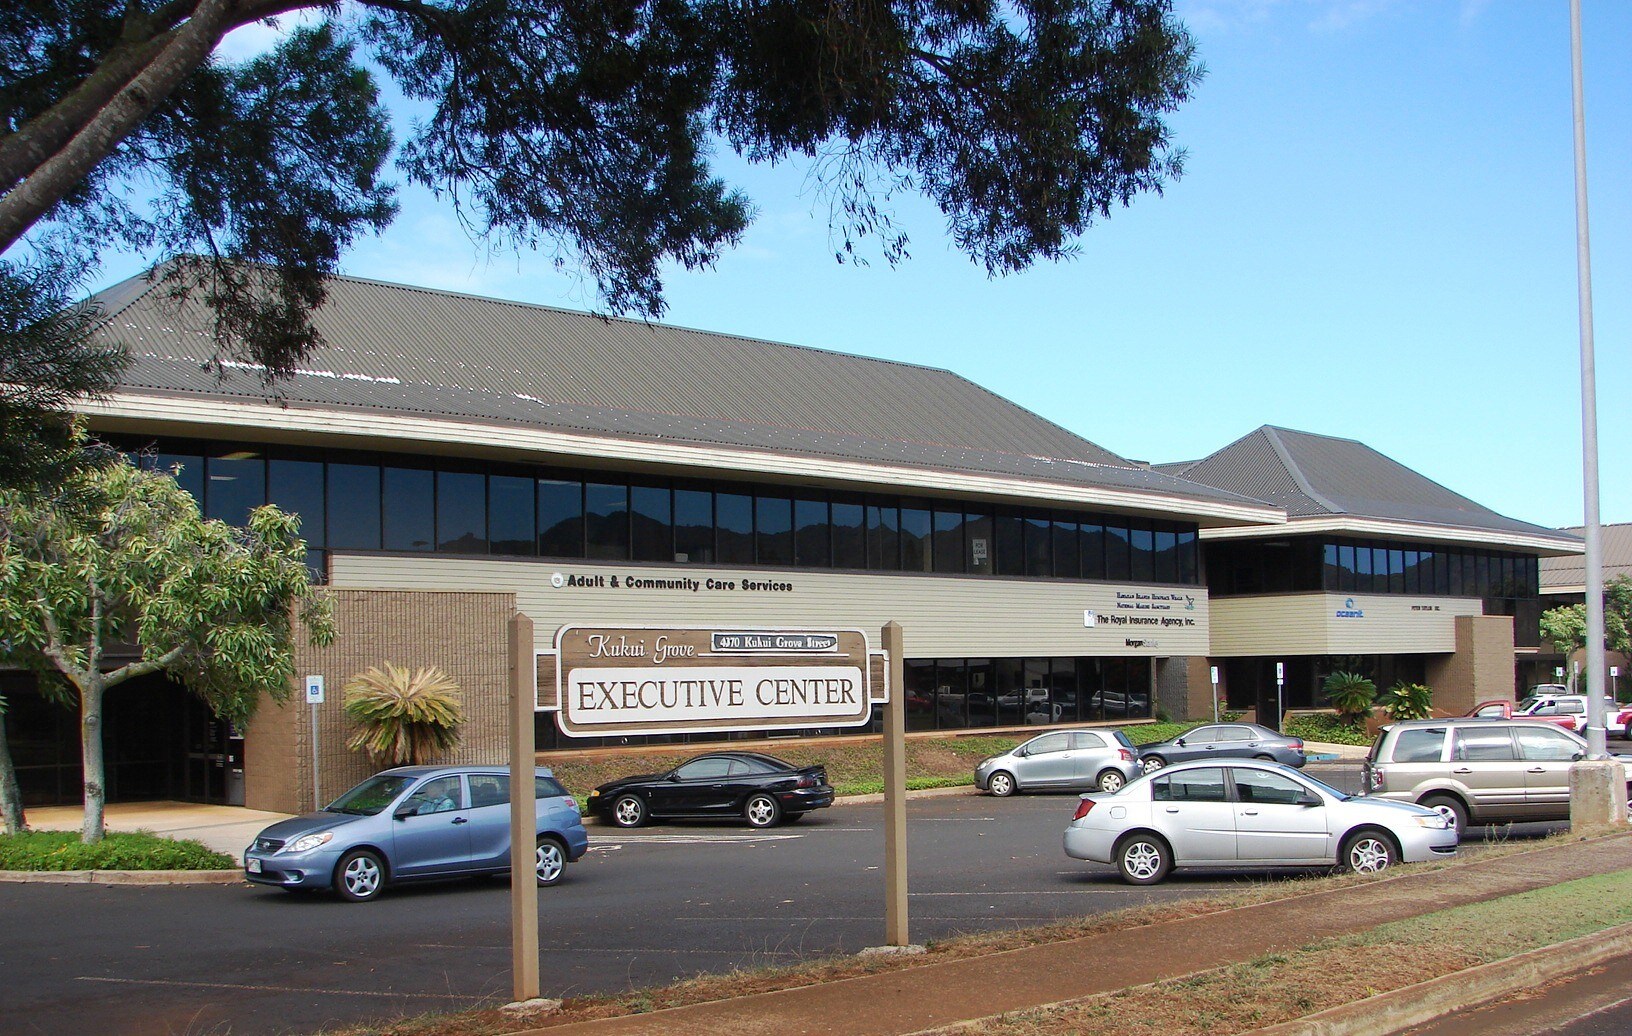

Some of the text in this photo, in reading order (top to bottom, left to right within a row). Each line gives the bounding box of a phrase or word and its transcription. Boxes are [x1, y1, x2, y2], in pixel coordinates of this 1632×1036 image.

[567, 574, 793, 592] Adult & Community Care Services
[1097, 614, 1109, 624] The
[1110, 615, 1128, 626] Royal
[1129, 616, 1159, 625] Insurance
[588, 634, 695, 664] Kukui Grove
[744, 636, 772, 648] Kukui
[576, 678, 857, 711] EXECUTIVE CENTER
